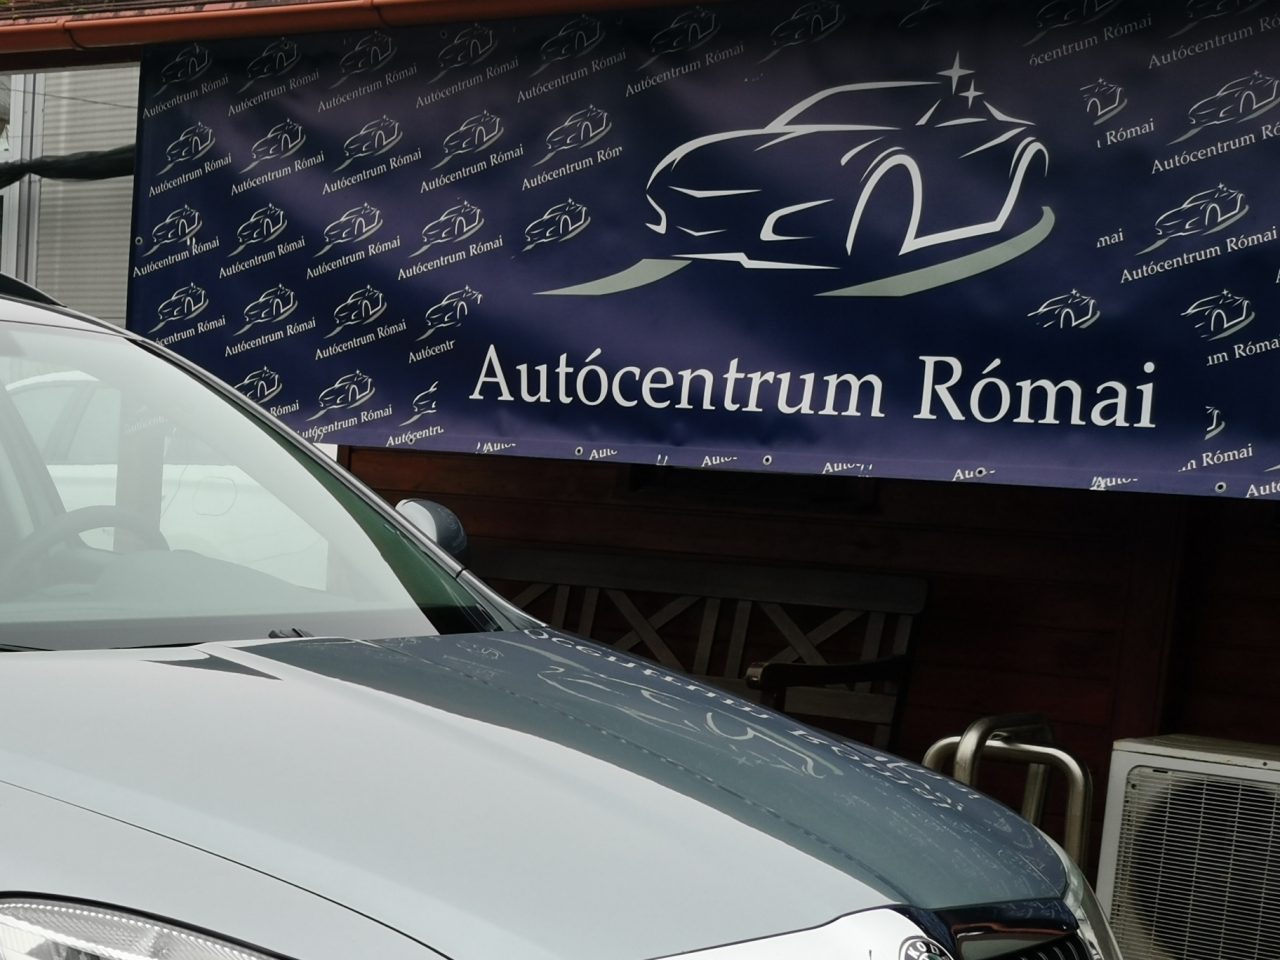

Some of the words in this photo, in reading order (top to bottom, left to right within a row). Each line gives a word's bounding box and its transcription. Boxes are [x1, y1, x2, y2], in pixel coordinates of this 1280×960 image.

[1104, 13, 1152, 41] Római
[1148, 25, 1253, 69] Autócentrum
[317, 80, 382, 112] Autócentrum
[385, 62, 417, 85] Római
[416, 75, 483, 108] Autócentrum
[486, 57, 519, 80] Római
[517, 68, 588, 103] Autócentrum
[591, 48, 626, 73] Római
[625, 60, 701, 97] Autócentrum
[705, 42, 744, 65] Római
[142, 88, 198, 119] Autócentrum
[201, 75, 229, 95] Római
[227, 84, 286, 117] Autócentrum
[1106, 119, 1155, 146] Római
[1151, 131, 1256, 174] Autócentrum
[149, 166, 202, 197] Autócentrum
[204, 152, 232, 174] Római
[231, 166, 291, 196] Autócentrum
[294, 150, 324, 171] Római
[322, 164, 387, 195] Autócentrum
[390, 148, 422, 169] Római
[420, 161, 487, 193] Autócentrum
[490, 144, 524, 167] Római
[522, 158, 593, 191] Autócentrum
[132, 249, 190, 277] Autócentrum
[219, 249, 277, 279] Autócentrum
[278, 236, 306, 256] Római
[306, 249, 365, 279] Autócentrum
[368, 236, 401, 256] Római
[398, 249, 466, 280] Autócentrum
[469, 235, 503, 256] Római
[1120, 245, 1221, 284] Autócentrum
[1226, 226, 1278, 252] Római
[197, 315, 226, 333] Római
[224, 329, 285, 357] Autócentrum
[286, 316, 316, 337] Római
[315, 331, 376, 360] Autócentrum
[377, 319, 407, 340] Római
[469, 343, 885, 418] Autócentrum
[913, 355, 1156, 428] Római
[297, 417, 358, 440] utócentrum
[361, 404, 393, 424] Római
[1202, 443, 1253, 467] Római
